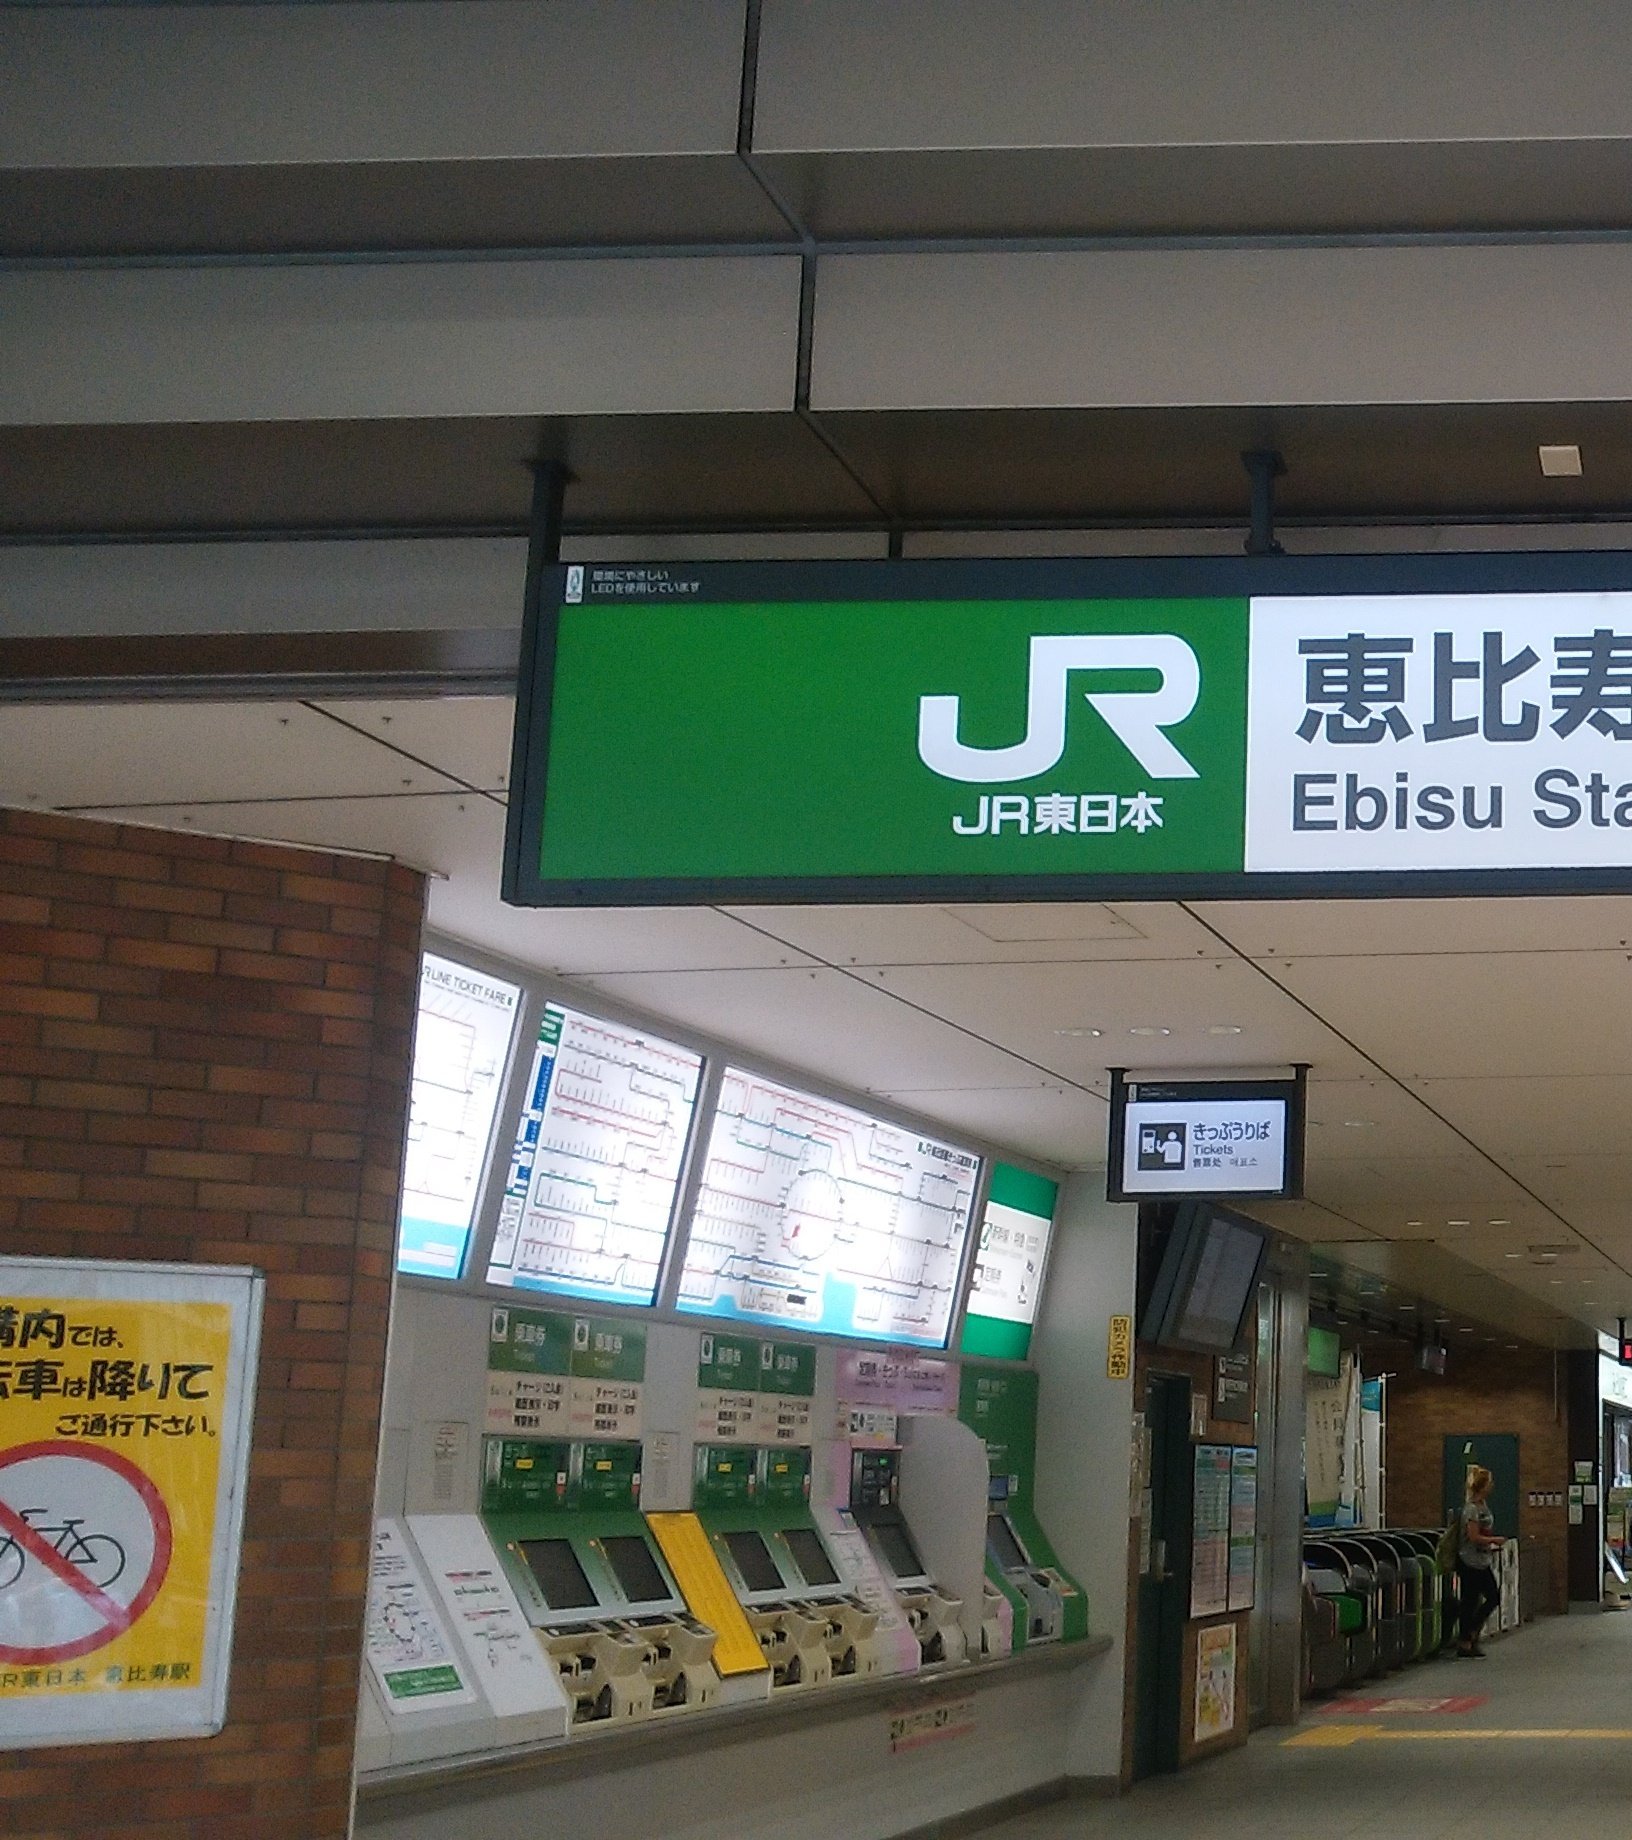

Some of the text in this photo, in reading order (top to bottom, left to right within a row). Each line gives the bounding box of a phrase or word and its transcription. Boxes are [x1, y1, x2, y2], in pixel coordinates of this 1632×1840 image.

[917, 633, 1201, 783] JR
[952, 791, 1164, 835] JR東日本
[1292, 771, 1503, 832] Ebisu
[1193, 1120, 1271, 1141] きっぷうりば
[1193, 1144, 1234, 1156] Tickets
[0, 1358, 214, 1400] 車は降りて
[55, 1412, 216, 1437] ご通行下さい。
[0, 1669, 86, 1689] R東日本
